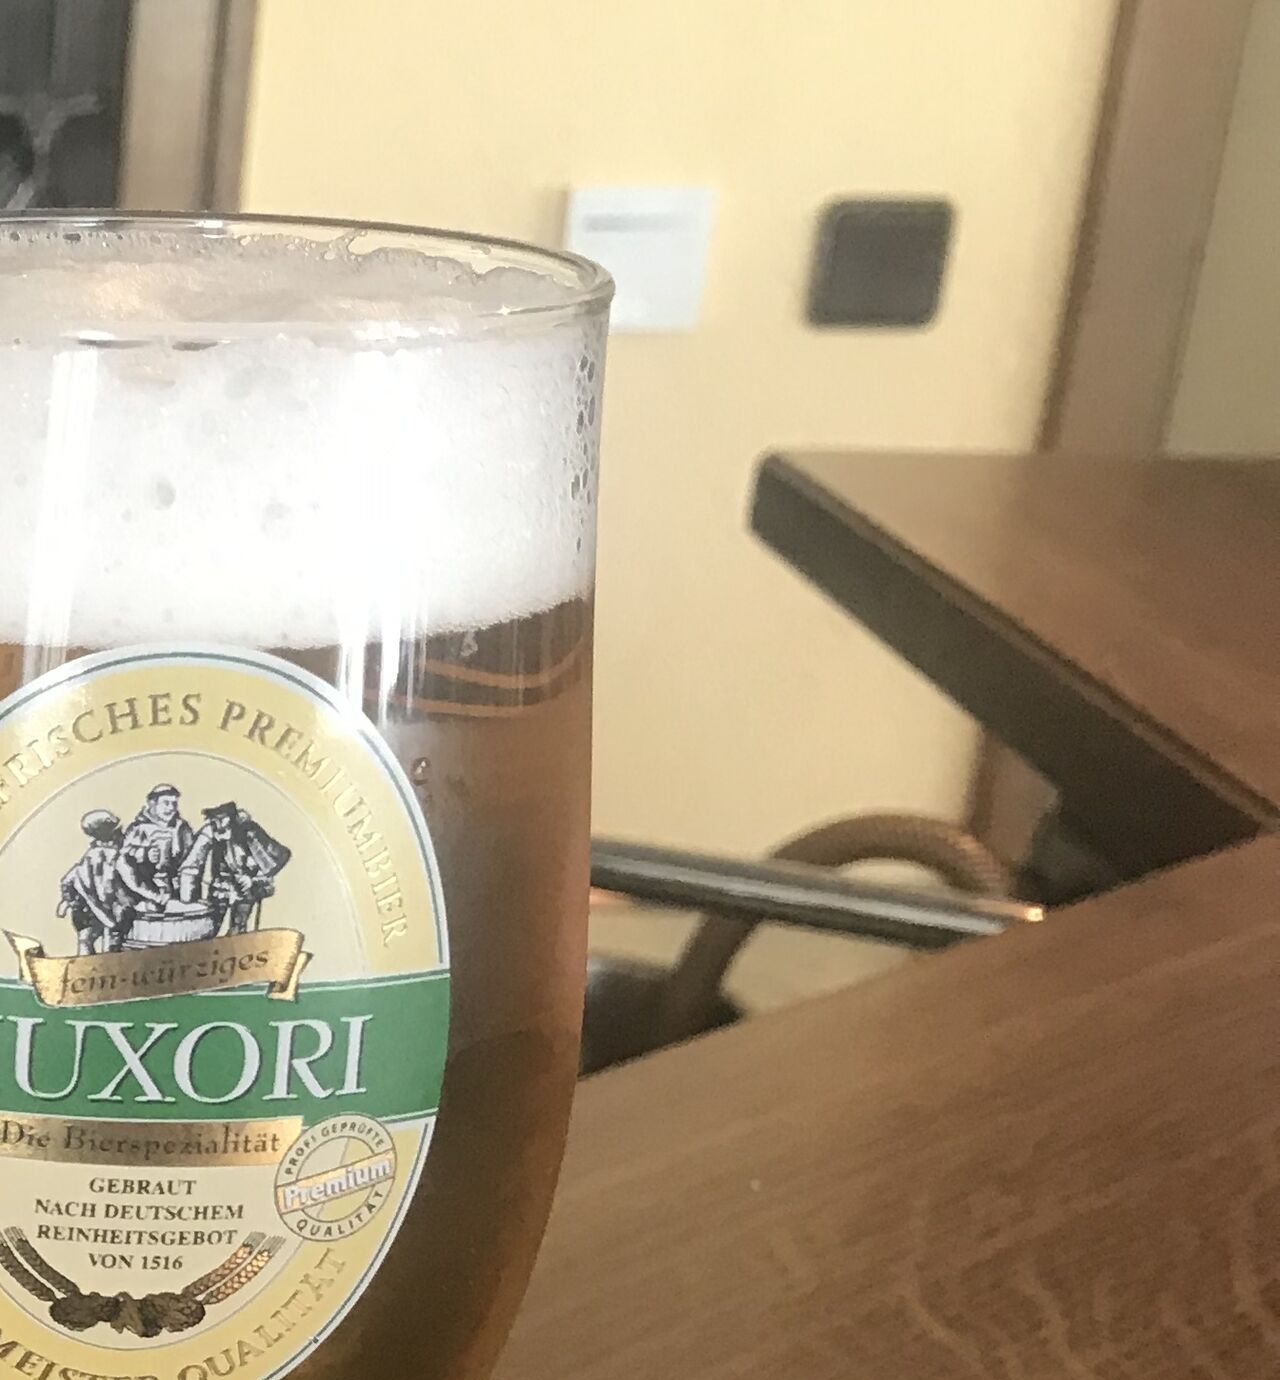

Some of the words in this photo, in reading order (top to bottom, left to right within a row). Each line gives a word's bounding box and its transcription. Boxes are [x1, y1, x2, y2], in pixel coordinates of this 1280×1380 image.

[219, 697, 410, 947] PREMIUMBIER
[57, 949, 269, 1004] fein-würziges
[62, 1122, 281, 1160] Bierspezialität
[284, 1135, 318, 1176] PROFI
[321, 1121, 385, 1149] GEPRÜFTE
[88, 1177, 197, 1196] GEBRAUT
[282, 1158, 392, 1211] Premium
[34, 1198, 97, 1218] NACH
[104, 1203, 244, 1221] DEUTSCHEM
[296, 1190, 384, 1237] QUALITÄT
[37, 1224, 238, 1246] REINHEITSGEBOT
[88, 1253, 134, 1270] VON
[141, 1255, 184, 1271] 1516
